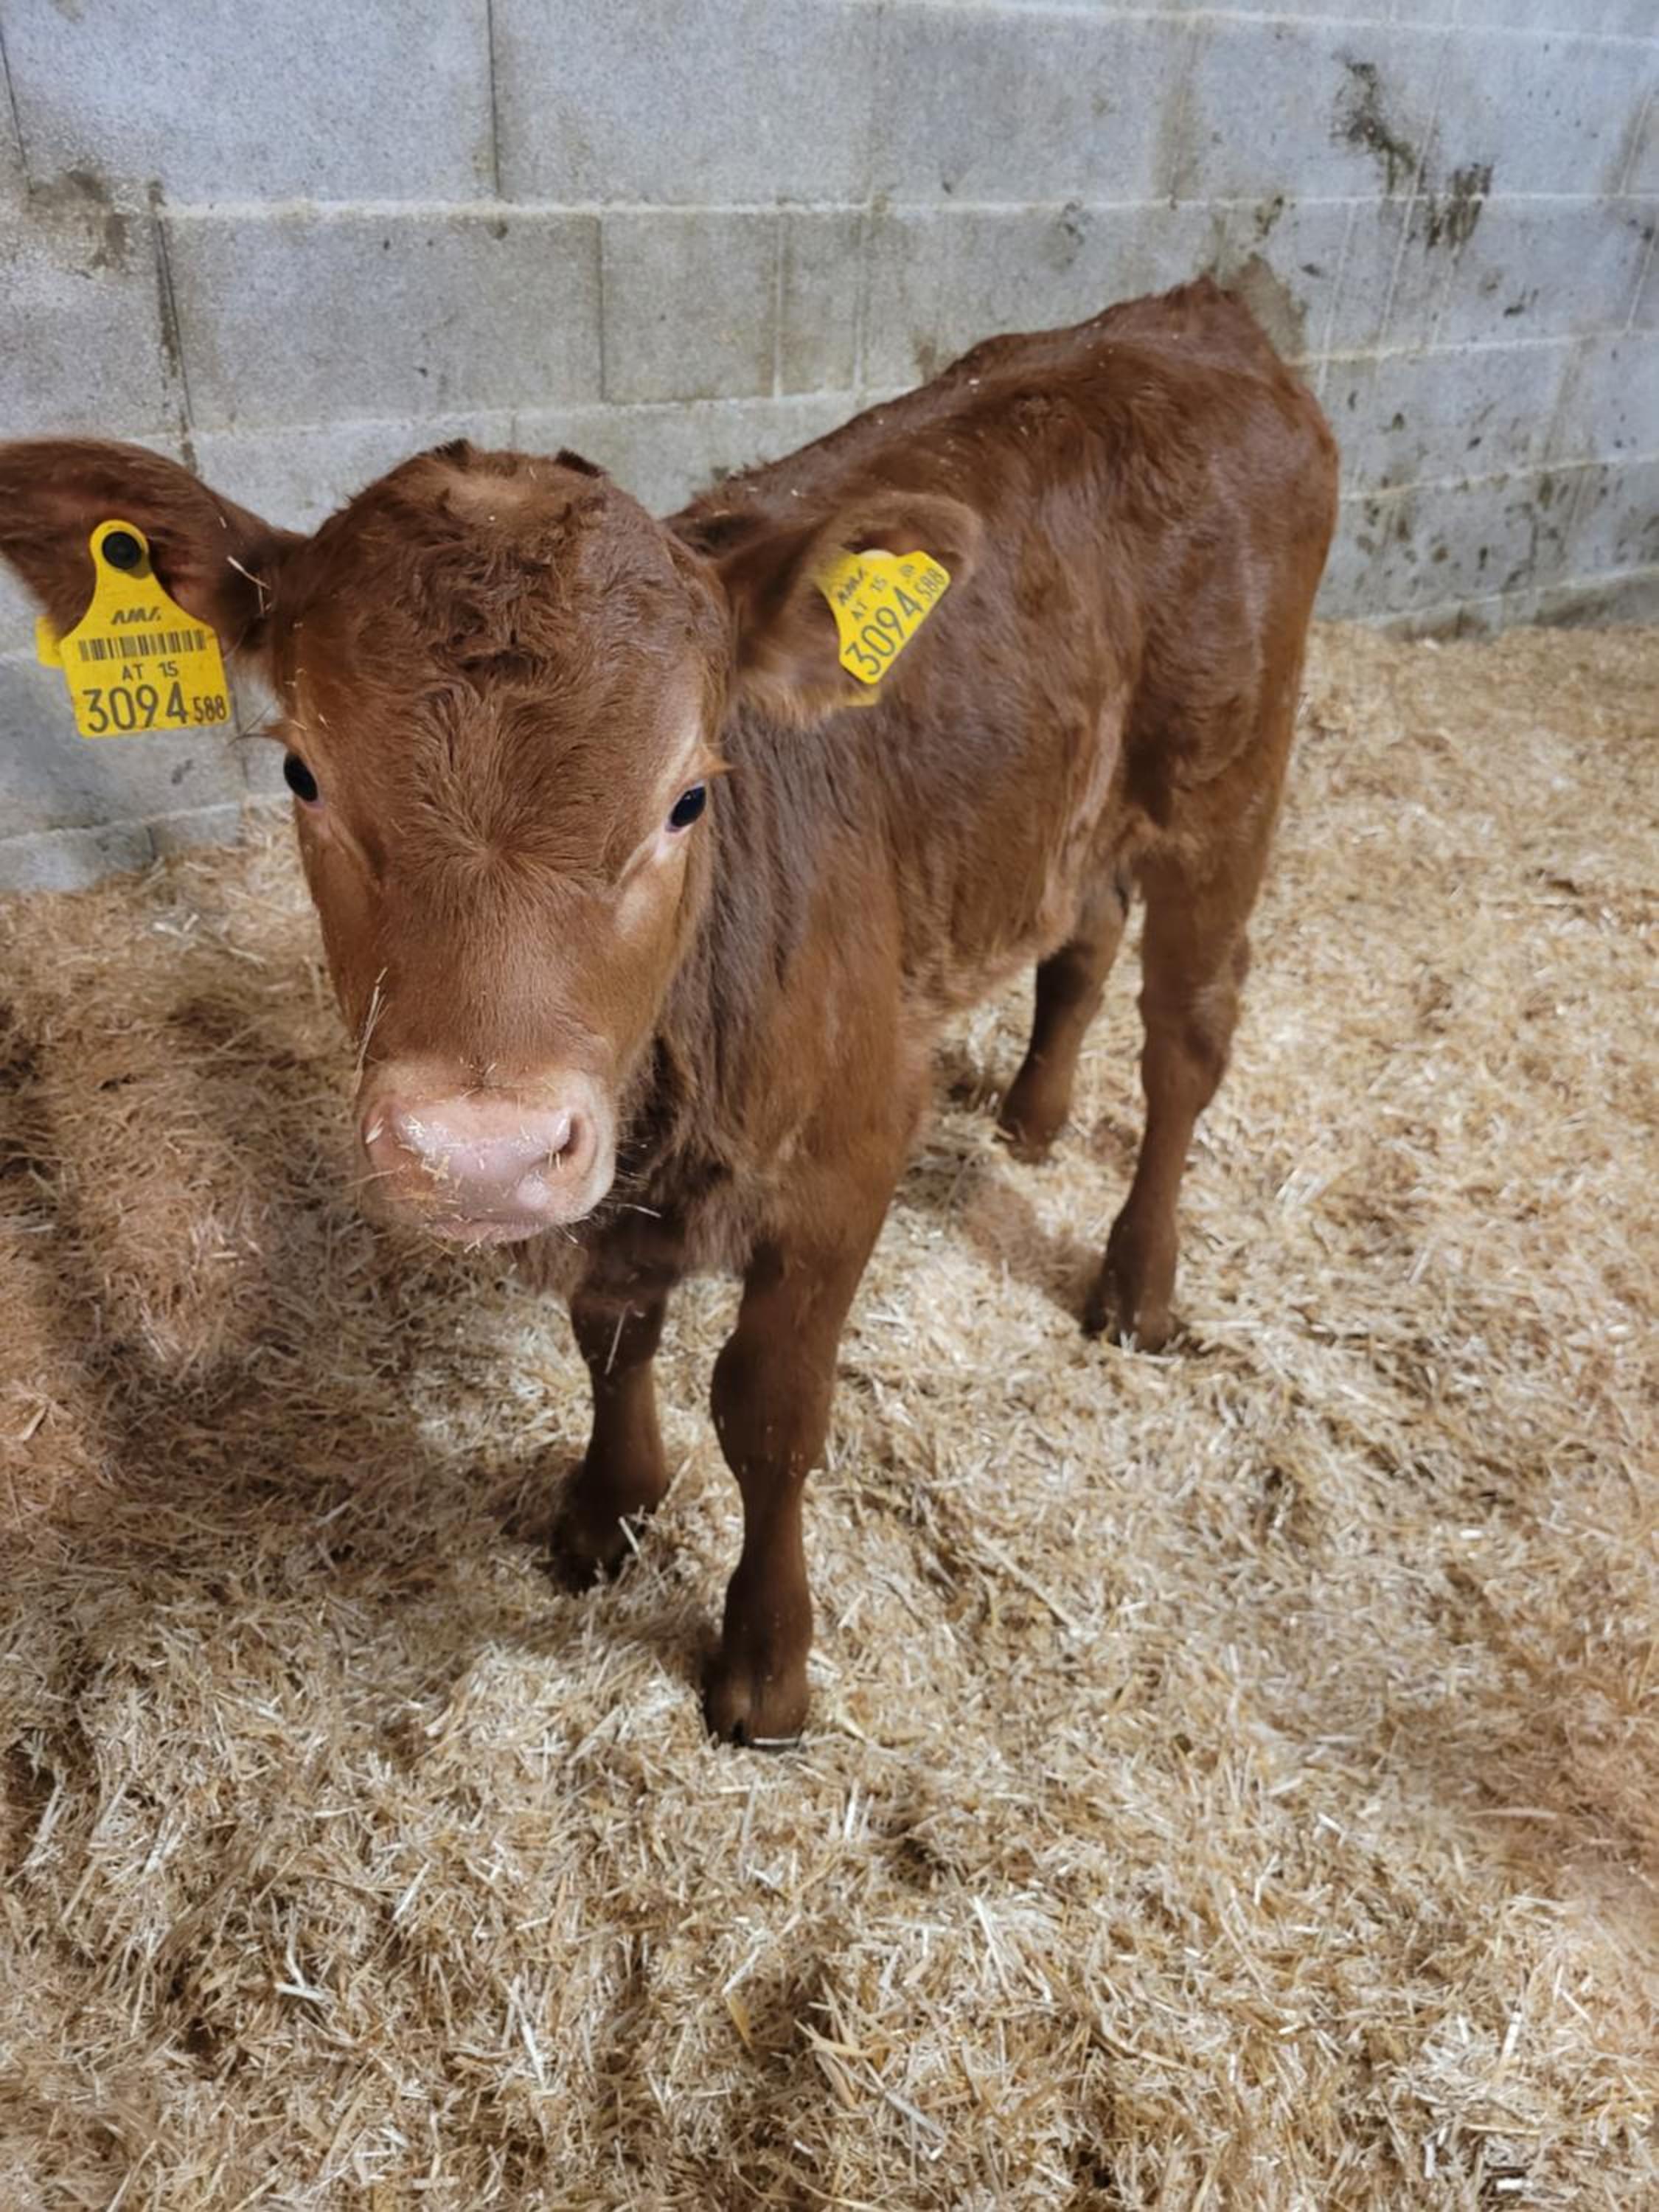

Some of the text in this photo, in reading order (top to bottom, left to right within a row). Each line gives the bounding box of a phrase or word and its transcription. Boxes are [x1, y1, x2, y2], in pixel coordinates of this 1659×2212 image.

[845, 568, 945, 675] 3094 588
[122, 661, 178, 681] AT 15
[83, 681, 226, 733] 3094 588
